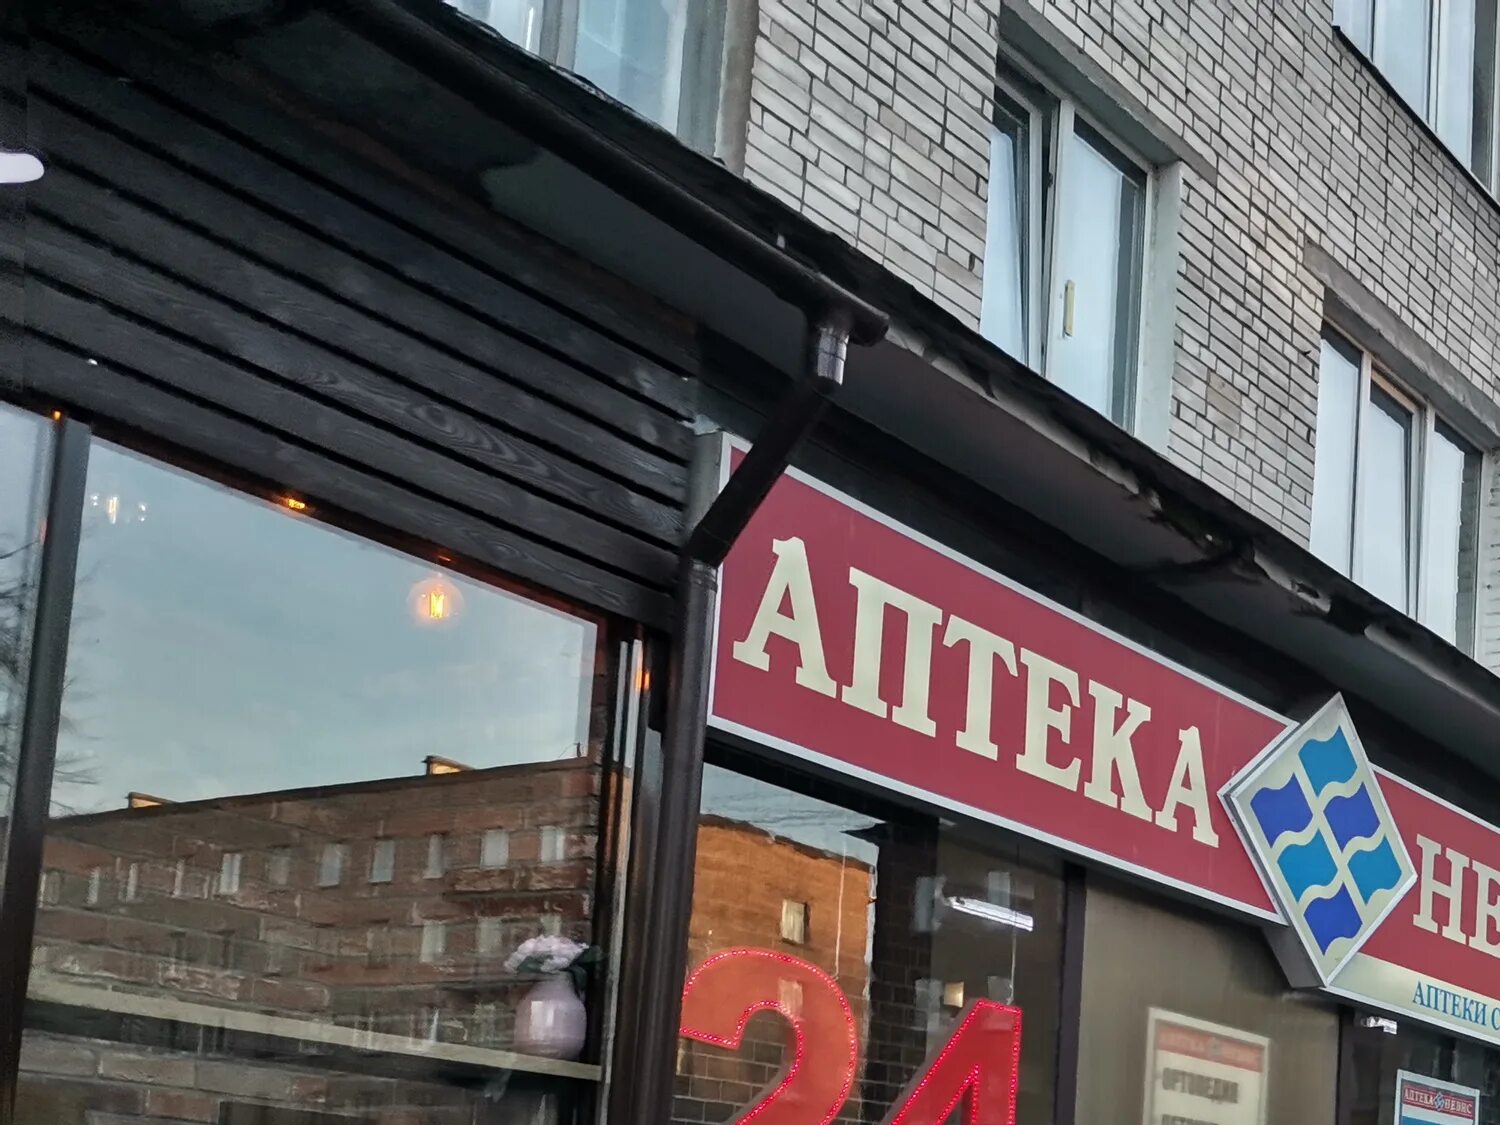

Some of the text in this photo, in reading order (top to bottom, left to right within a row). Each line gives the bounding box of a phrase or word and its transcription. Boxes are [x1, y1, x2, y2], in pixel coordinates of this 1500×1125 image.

[733, 536, 1220, 848] АПТЕКА
[1412, 981, 1488, 1027] АПТЕКИ
[1404, 1088, 1473, 1115] АПТЕКА НЕВИС
